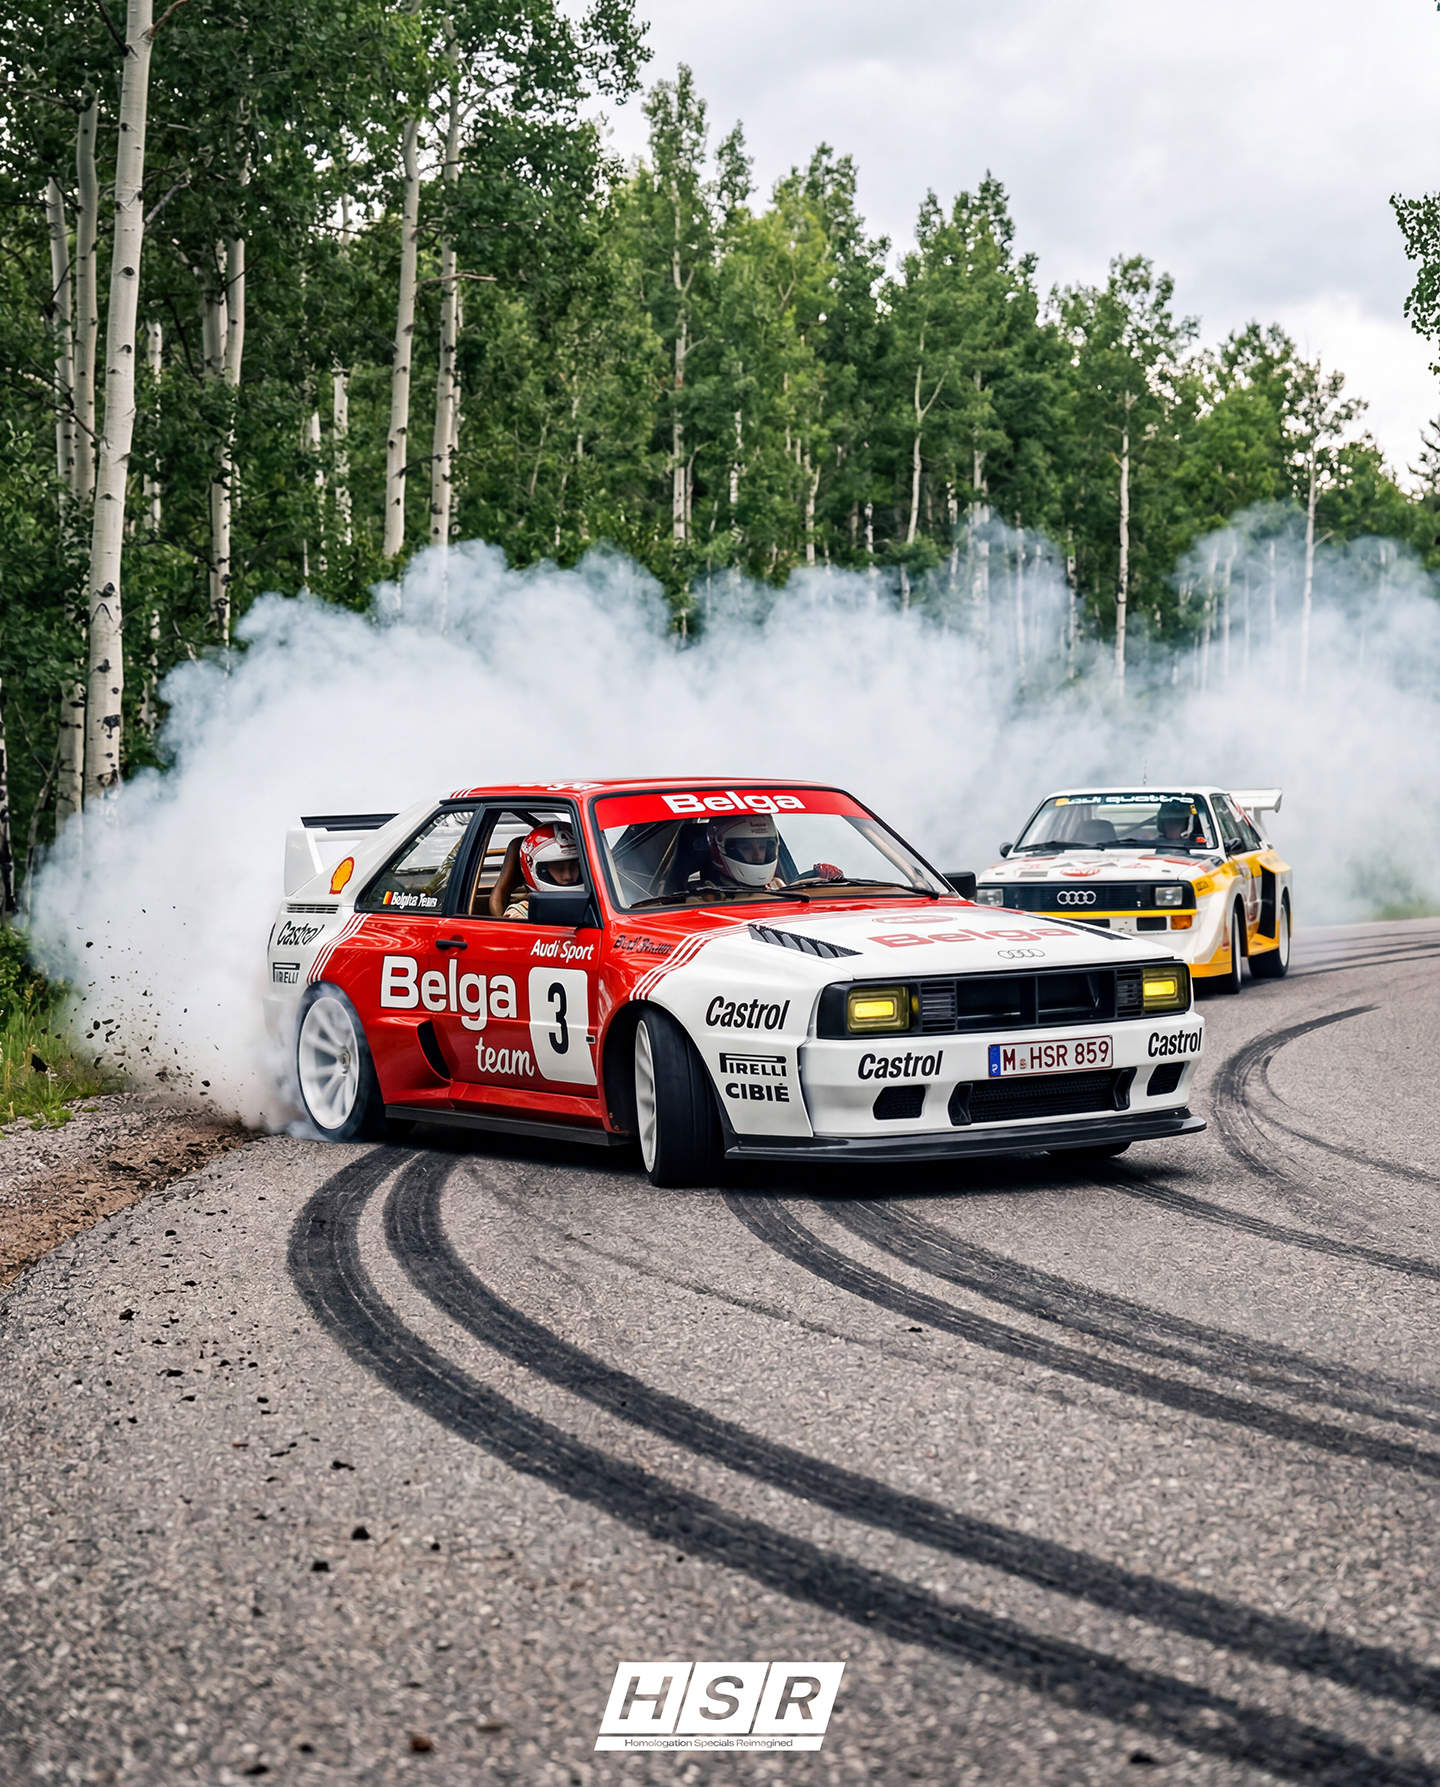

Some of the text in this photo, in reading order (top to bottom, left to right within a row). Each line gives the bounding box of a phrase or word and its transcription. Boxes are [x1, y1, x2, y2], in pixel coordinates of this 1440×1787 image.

[661, 791, 806, 814] Belga
[277, 920, 326, 946] Castrol
[867, 928, 1080, 948] Belga
[530, 938, 560, 957] Audi
[559, 940, 594, 963] Sport
[380, 955, 517, 1031] Belga
[547, 982, 569, 1054] 3
[706, 996, 790, 1030] Castrol
[475, 1037, 535, 1077] team
[1002, 1048, 1016, 1072] M
[1030, 1044, 1068, 1069] HSR
[1074, 1041, 1109, 1065] 859
[1148, 1027, 1202, 1057] Castrol
[719, 1053, 787, 1077] PIRELLI
[858, 1050, 943, 1080] Castrol
